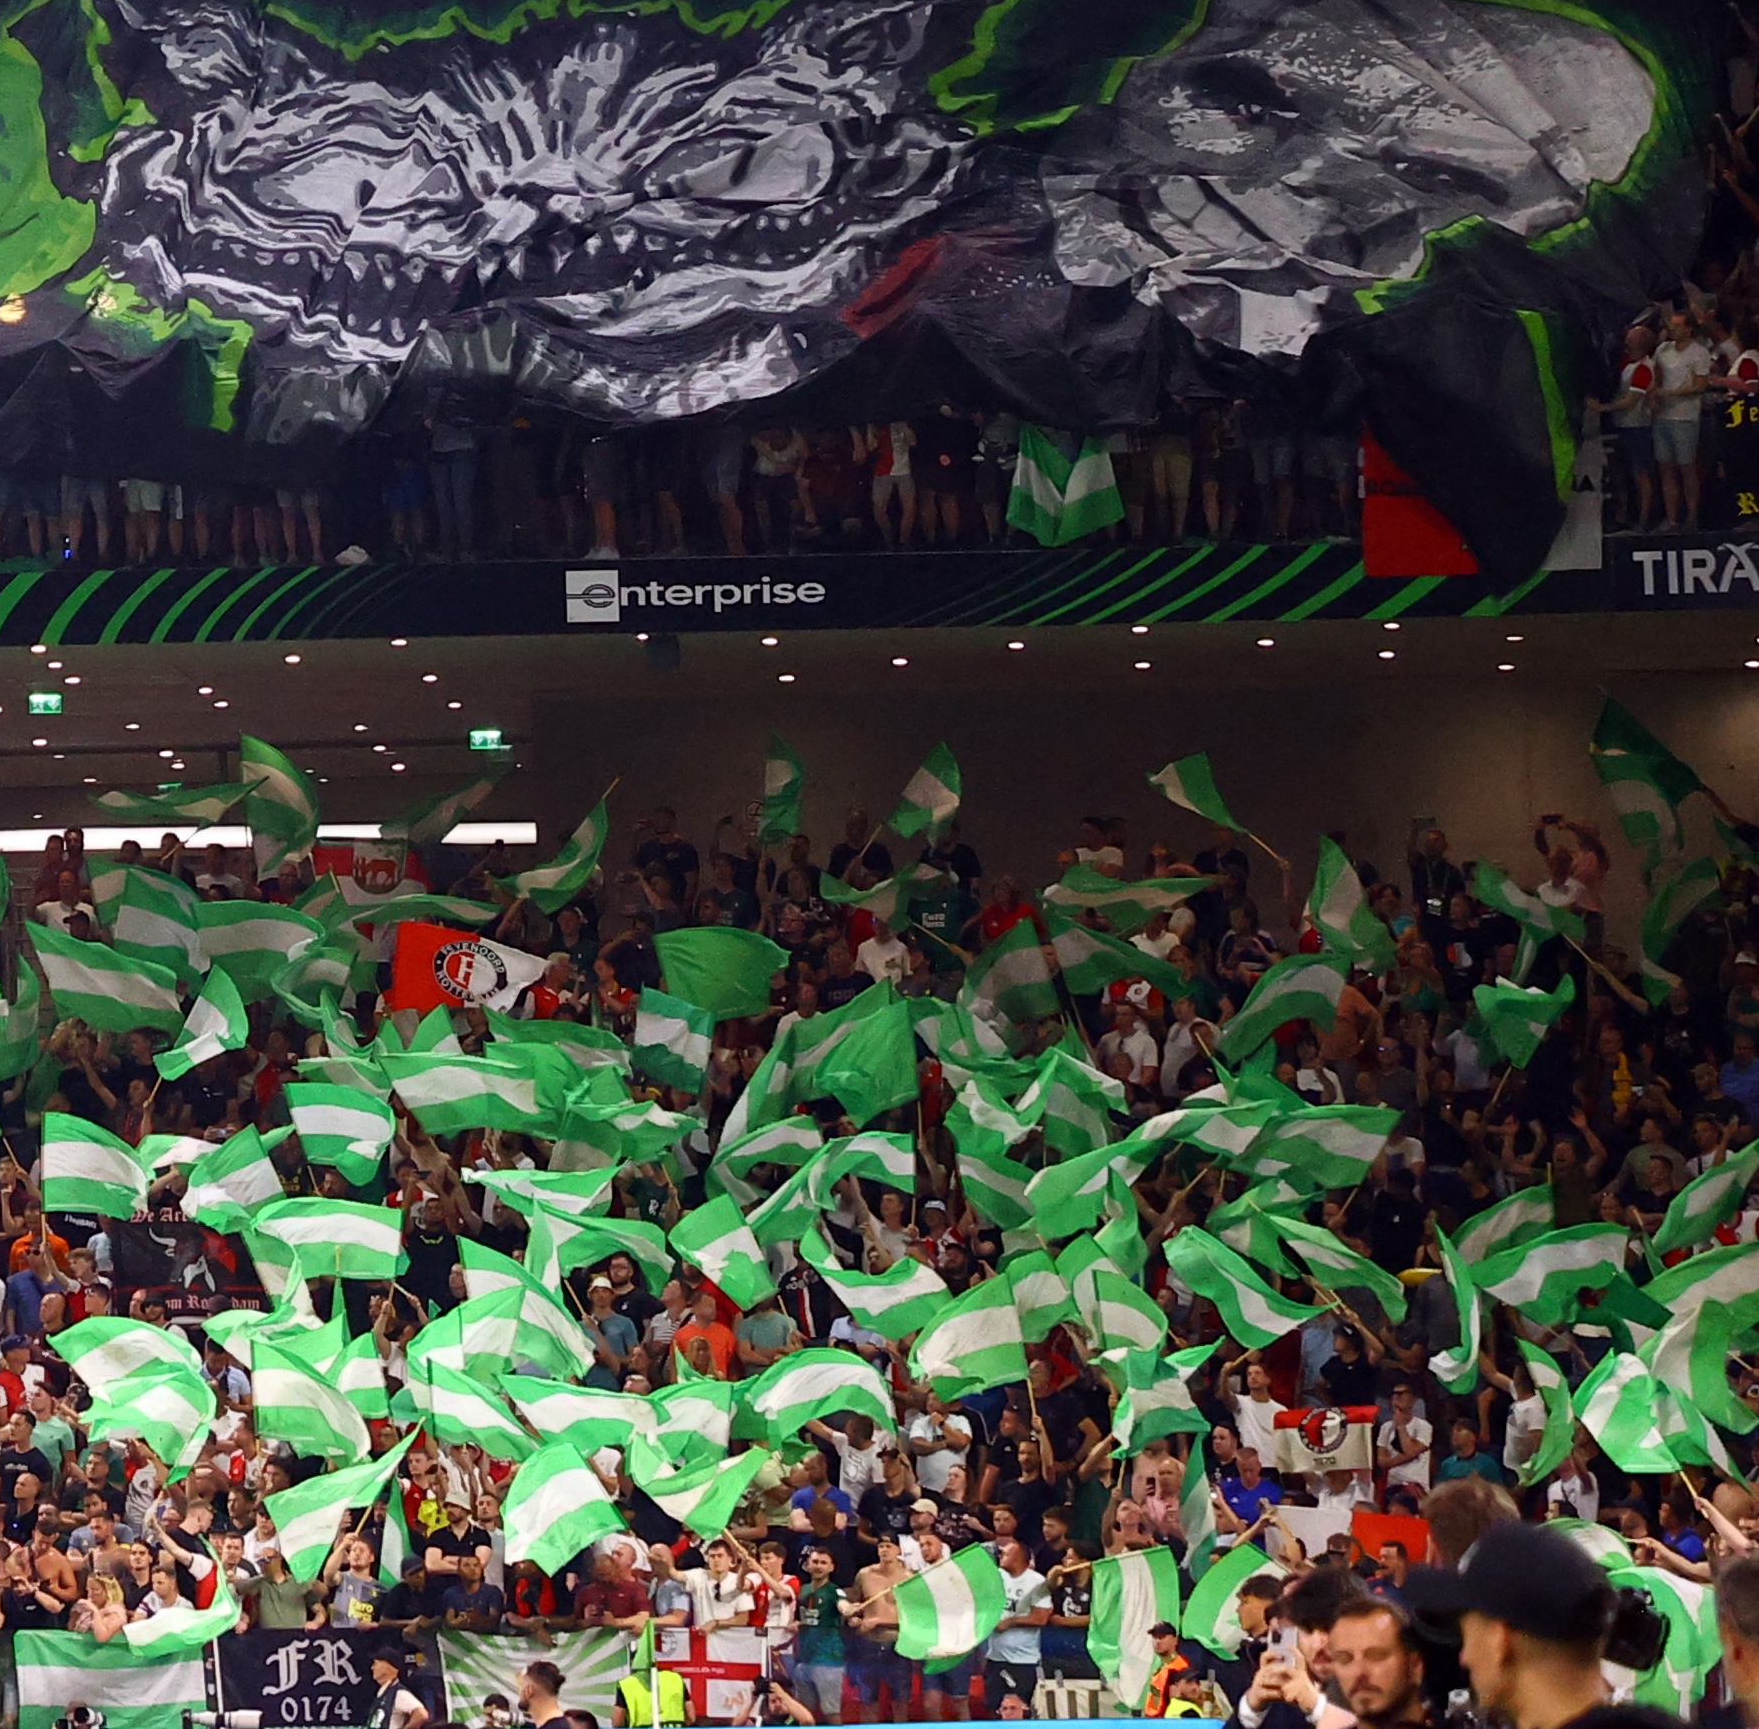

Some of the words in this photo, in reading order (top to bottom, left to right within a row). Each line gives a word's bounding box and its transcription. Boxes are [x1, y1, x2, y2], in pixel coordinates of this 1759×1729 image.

[566, 569, 826, 623] enterprise
[186, 1293, 260, 1312] Rodam
[280, 1695, 353, 1723] 0174
